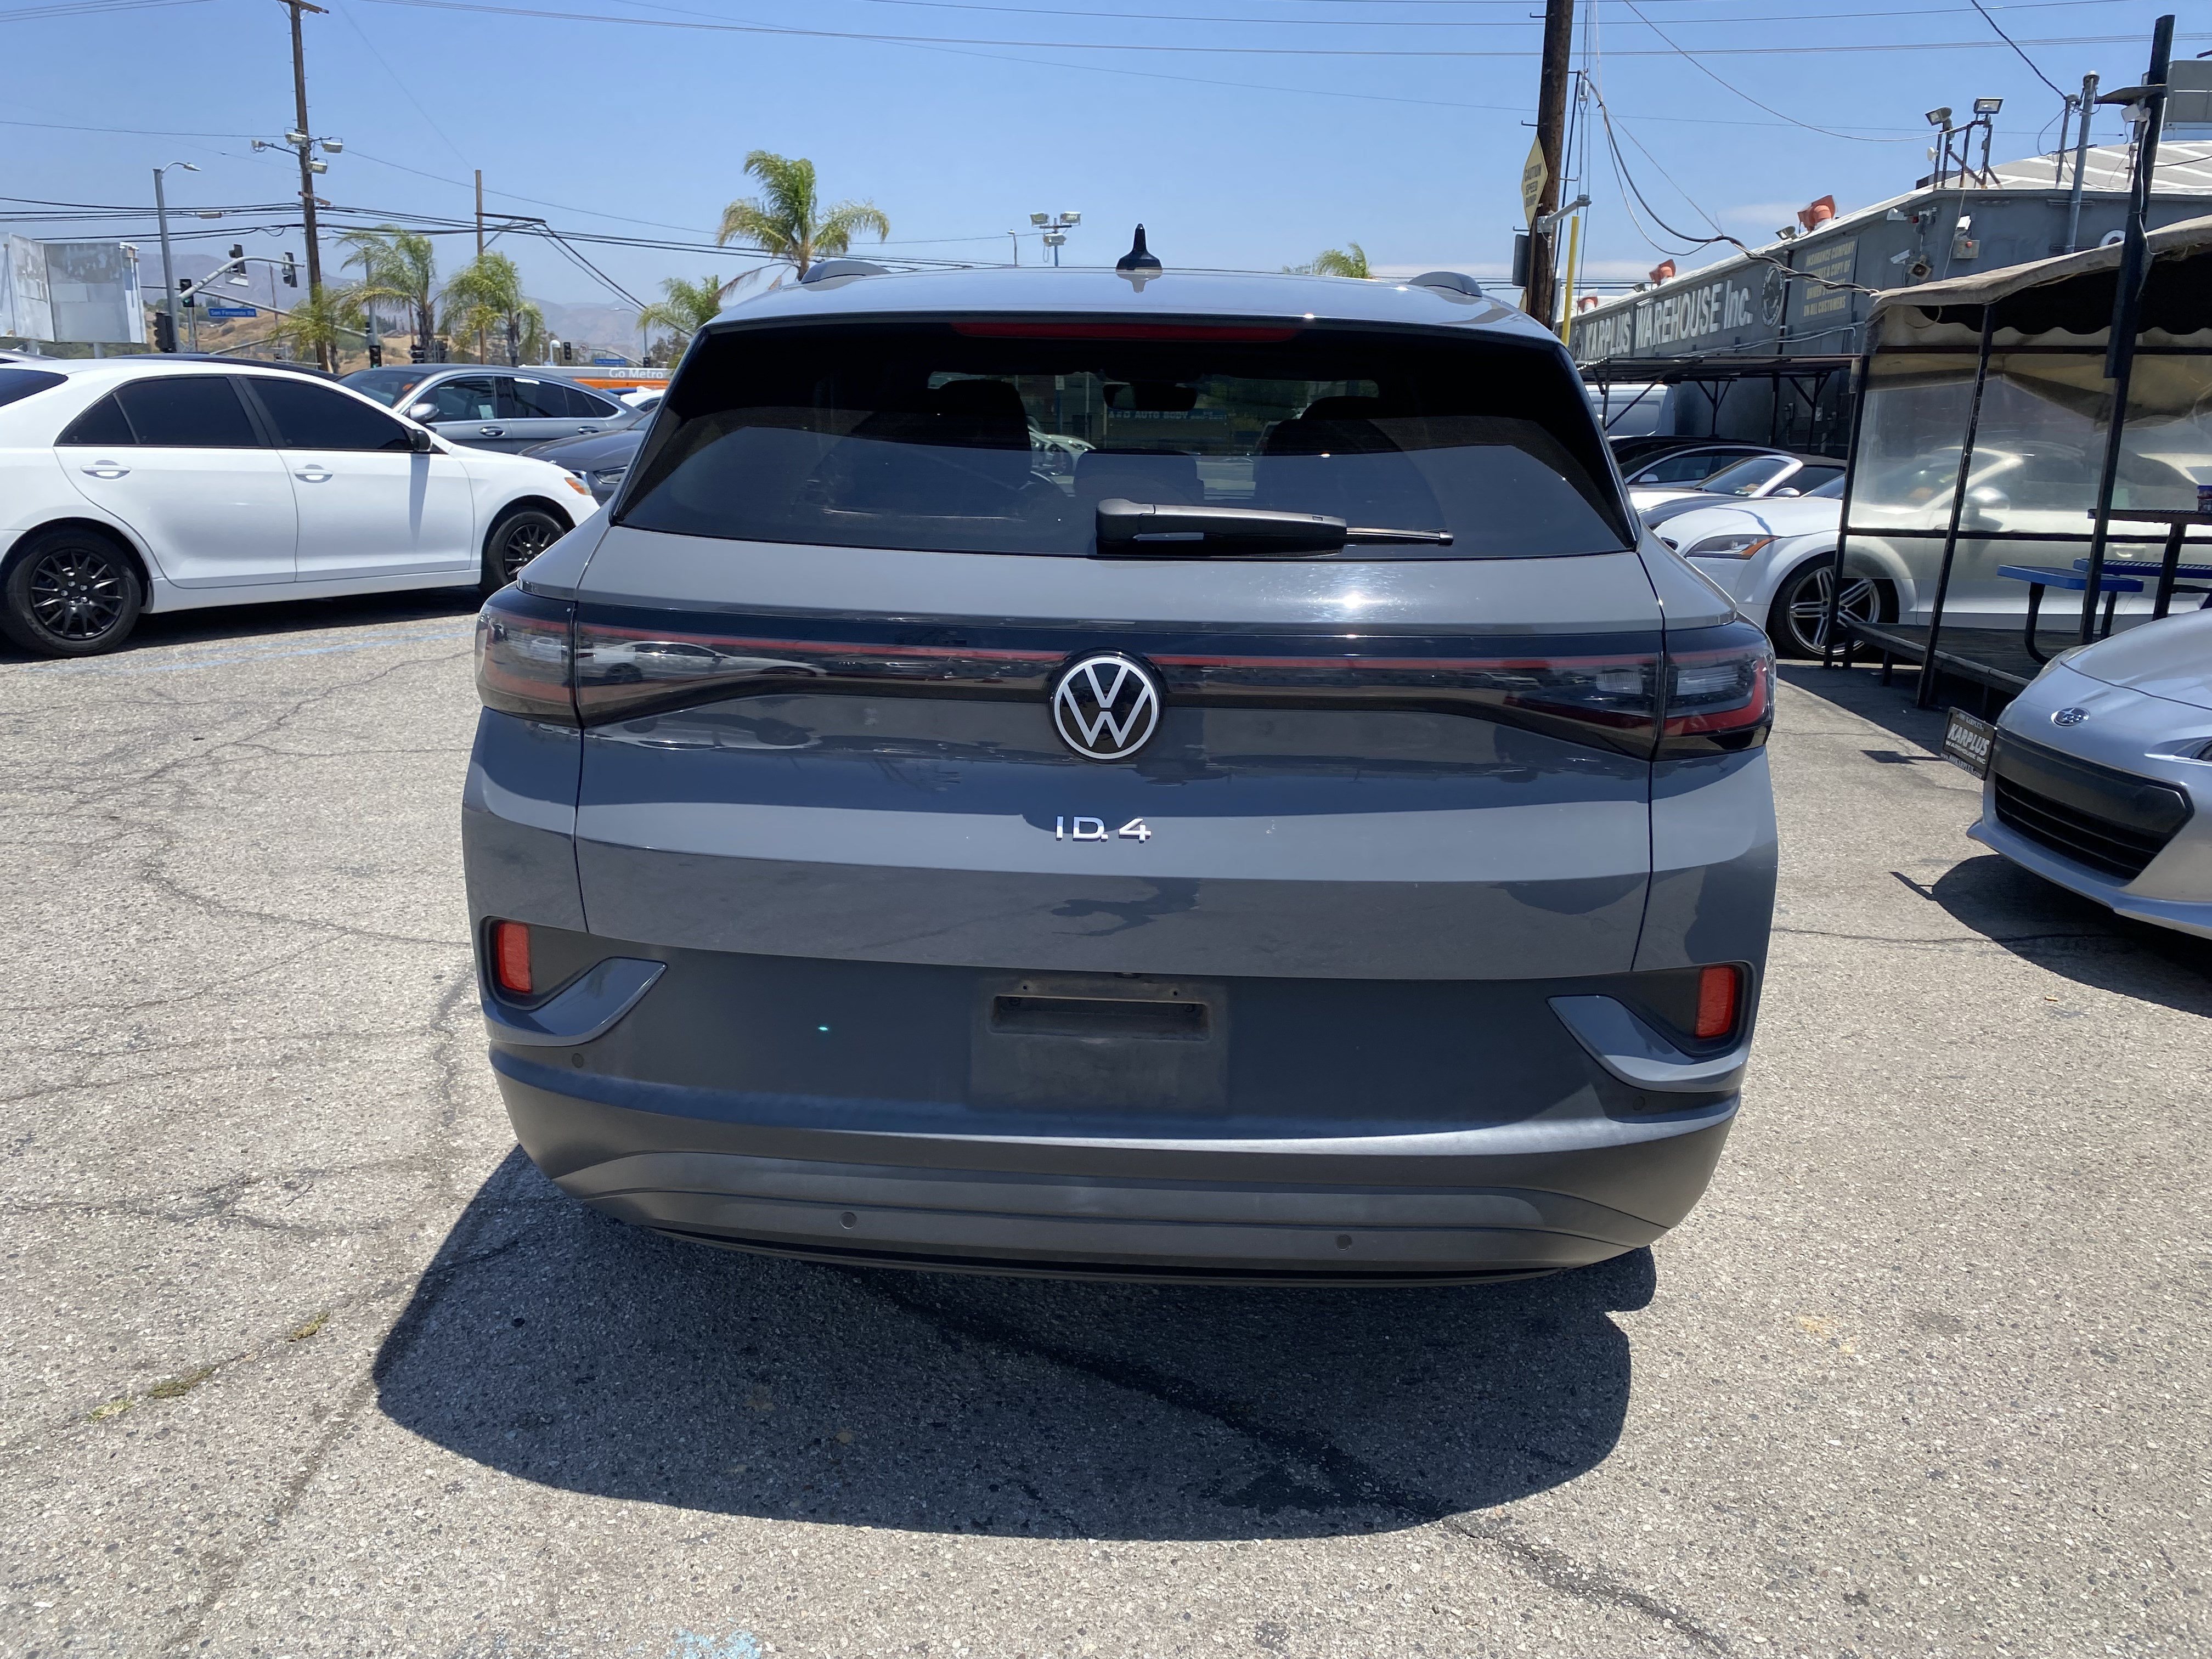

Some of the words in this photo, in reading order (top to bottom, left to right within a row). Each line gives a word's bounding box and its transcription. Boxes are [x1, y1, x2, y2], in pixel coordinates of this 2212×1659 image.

[1585, 311, 1632, 358] KARPLUS
[1635, 283, 1723, 349] WAREHOUSE
[1724, 280, 1753, 329] Inc.
[608, 369, 625, 379] Go
[629, 369, 663, 379] Metro
[1945, 740, 1976, 760] WAREHOUSE
[1947, 723, 1990, 756] KARPLUS
